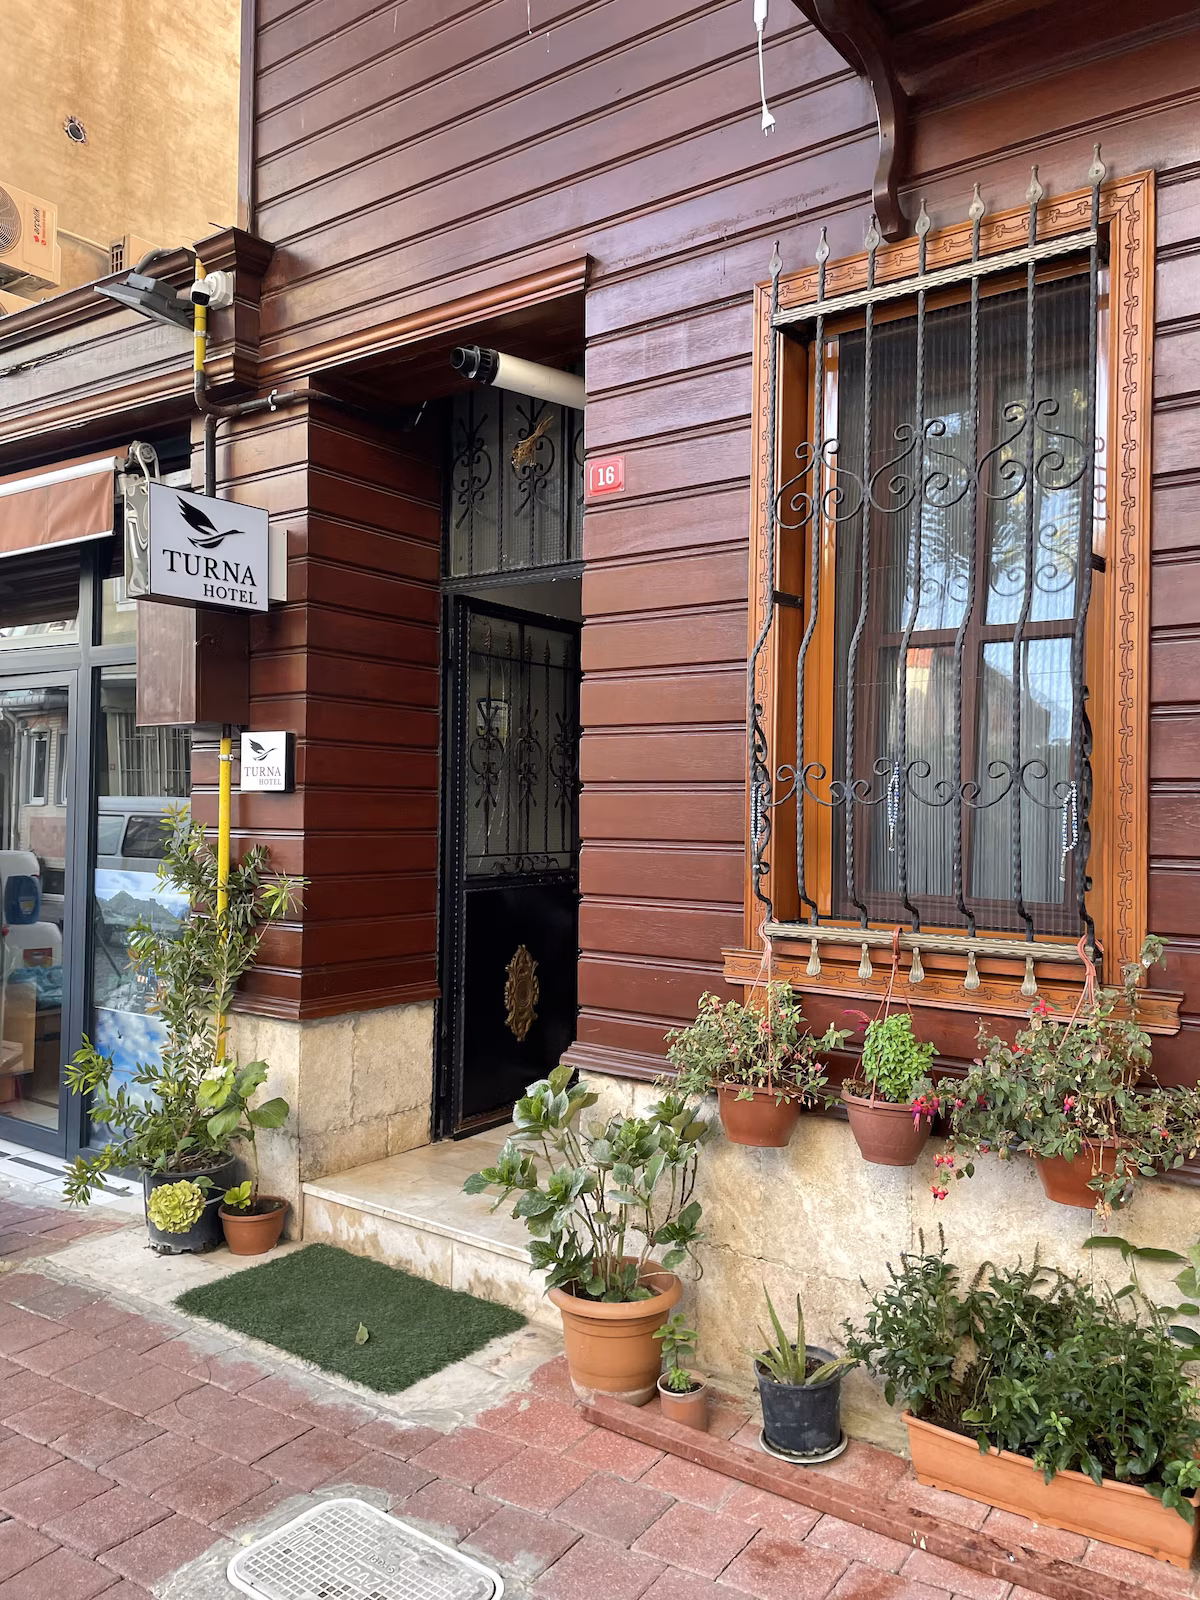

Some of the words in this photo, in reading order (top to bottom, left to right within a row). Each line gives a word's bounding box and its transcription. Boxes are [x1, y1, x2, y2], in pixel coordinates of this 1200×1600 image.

[597, 466, 614, 486] 16
[162, 549, 257, 587] TURNA
[203, 583, 258, 605] HOTEL
[244, 766, 281, 777] TURNA
[258, 778, 282, 786] HOTEL
[343, 1565, 383, 1590] GAZ
